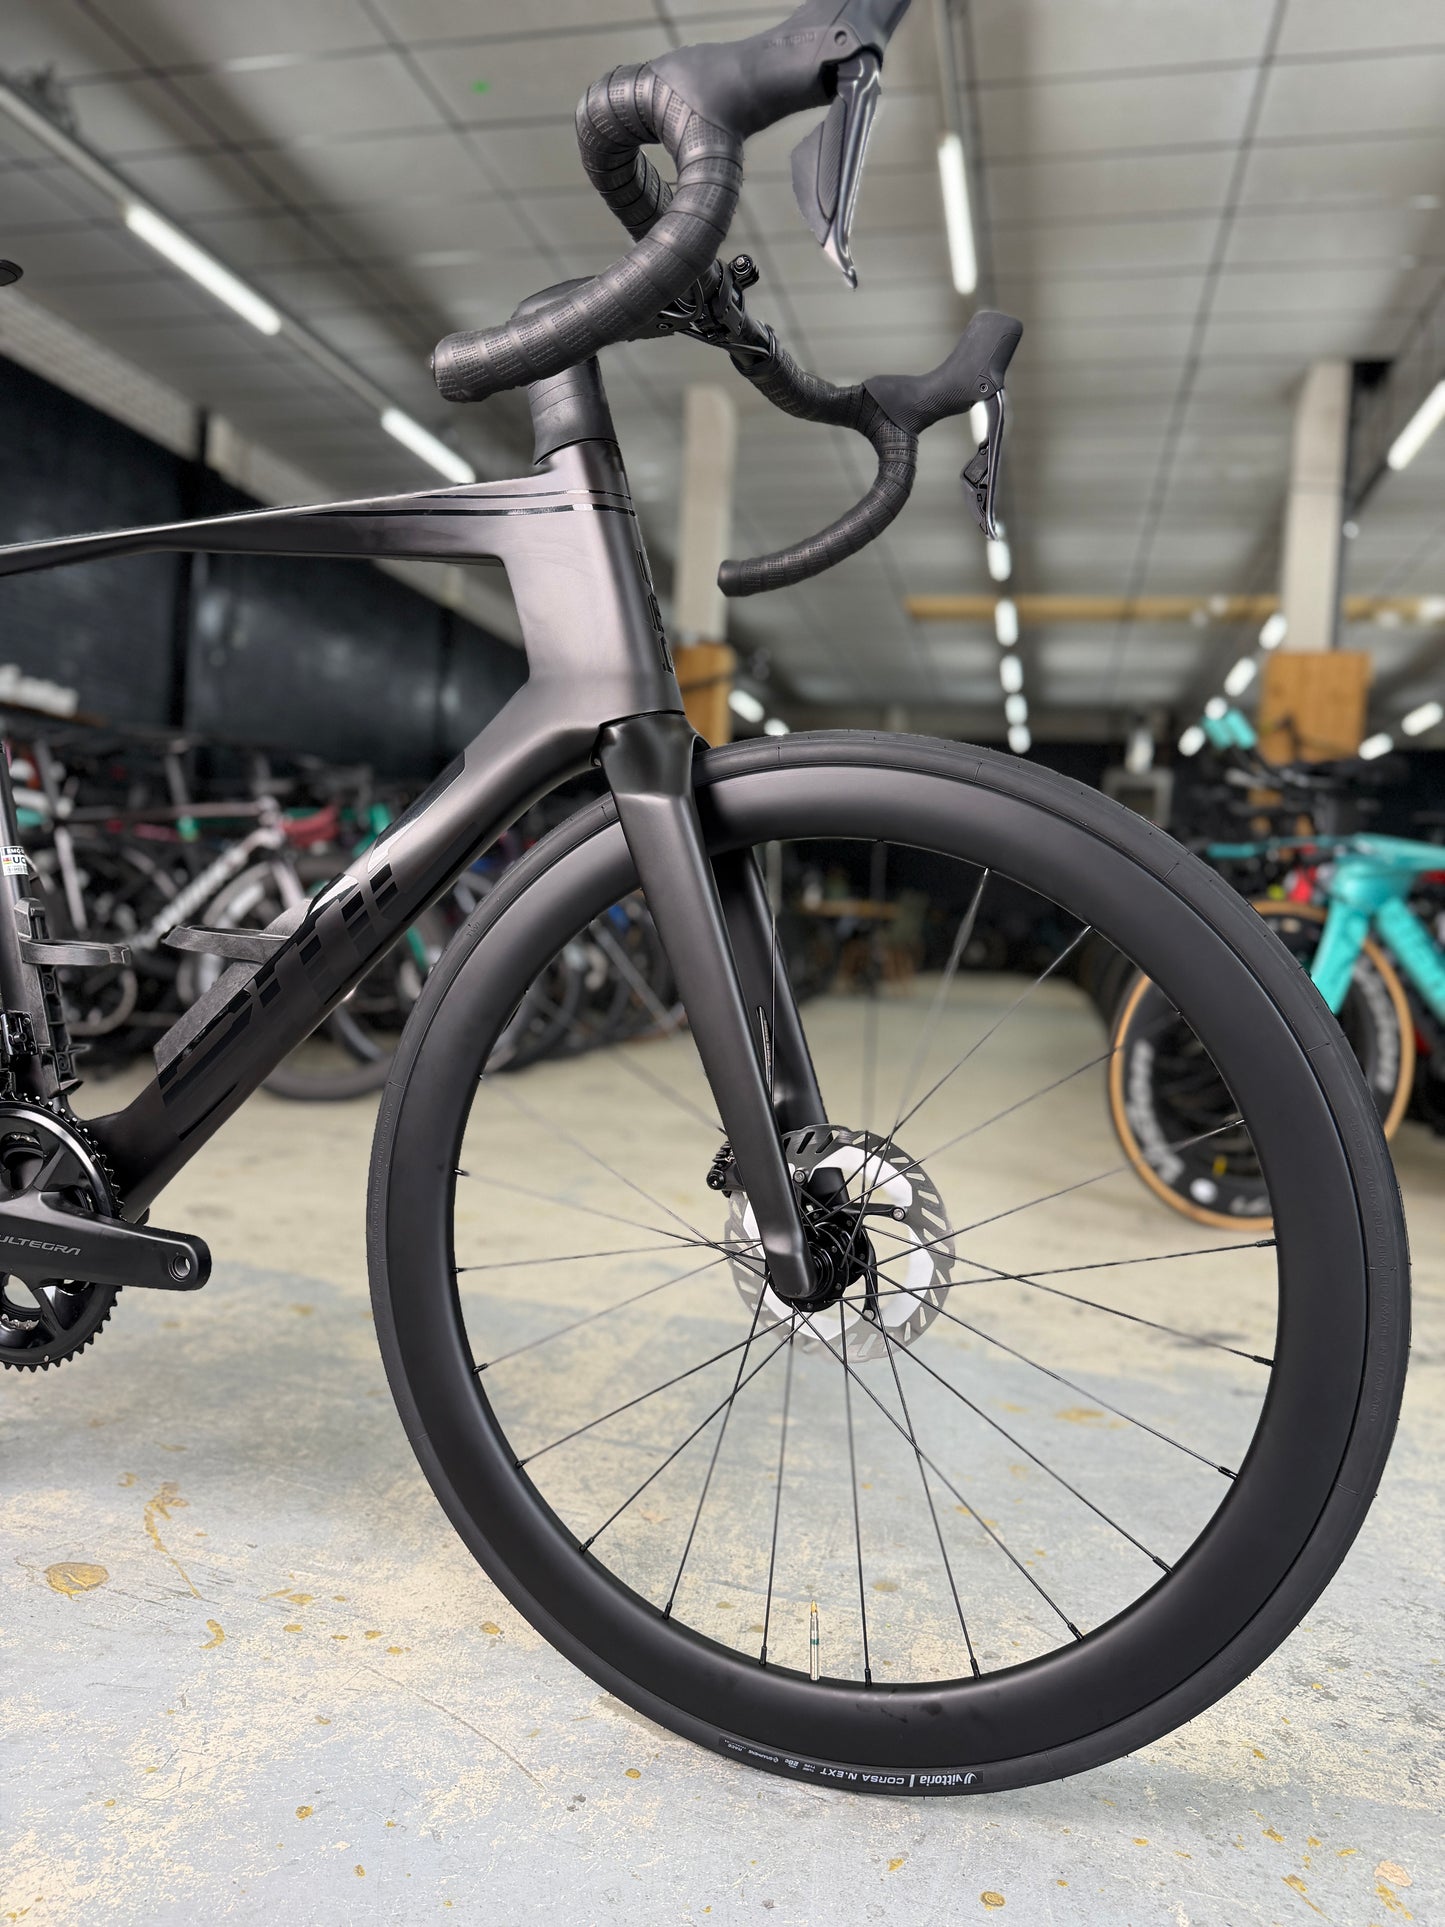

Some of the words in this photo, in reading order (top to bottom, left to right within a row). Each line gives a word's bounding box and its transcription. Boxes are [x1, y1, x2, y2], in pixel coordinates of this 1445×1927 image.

[0, 1234, 81, 1256] ULTEGRA
[820, 1767, 858, 1781] N.EXT
[862, 1774, 905, 1785] CORSA
[919, 1774, 963, 1787] vittoria
